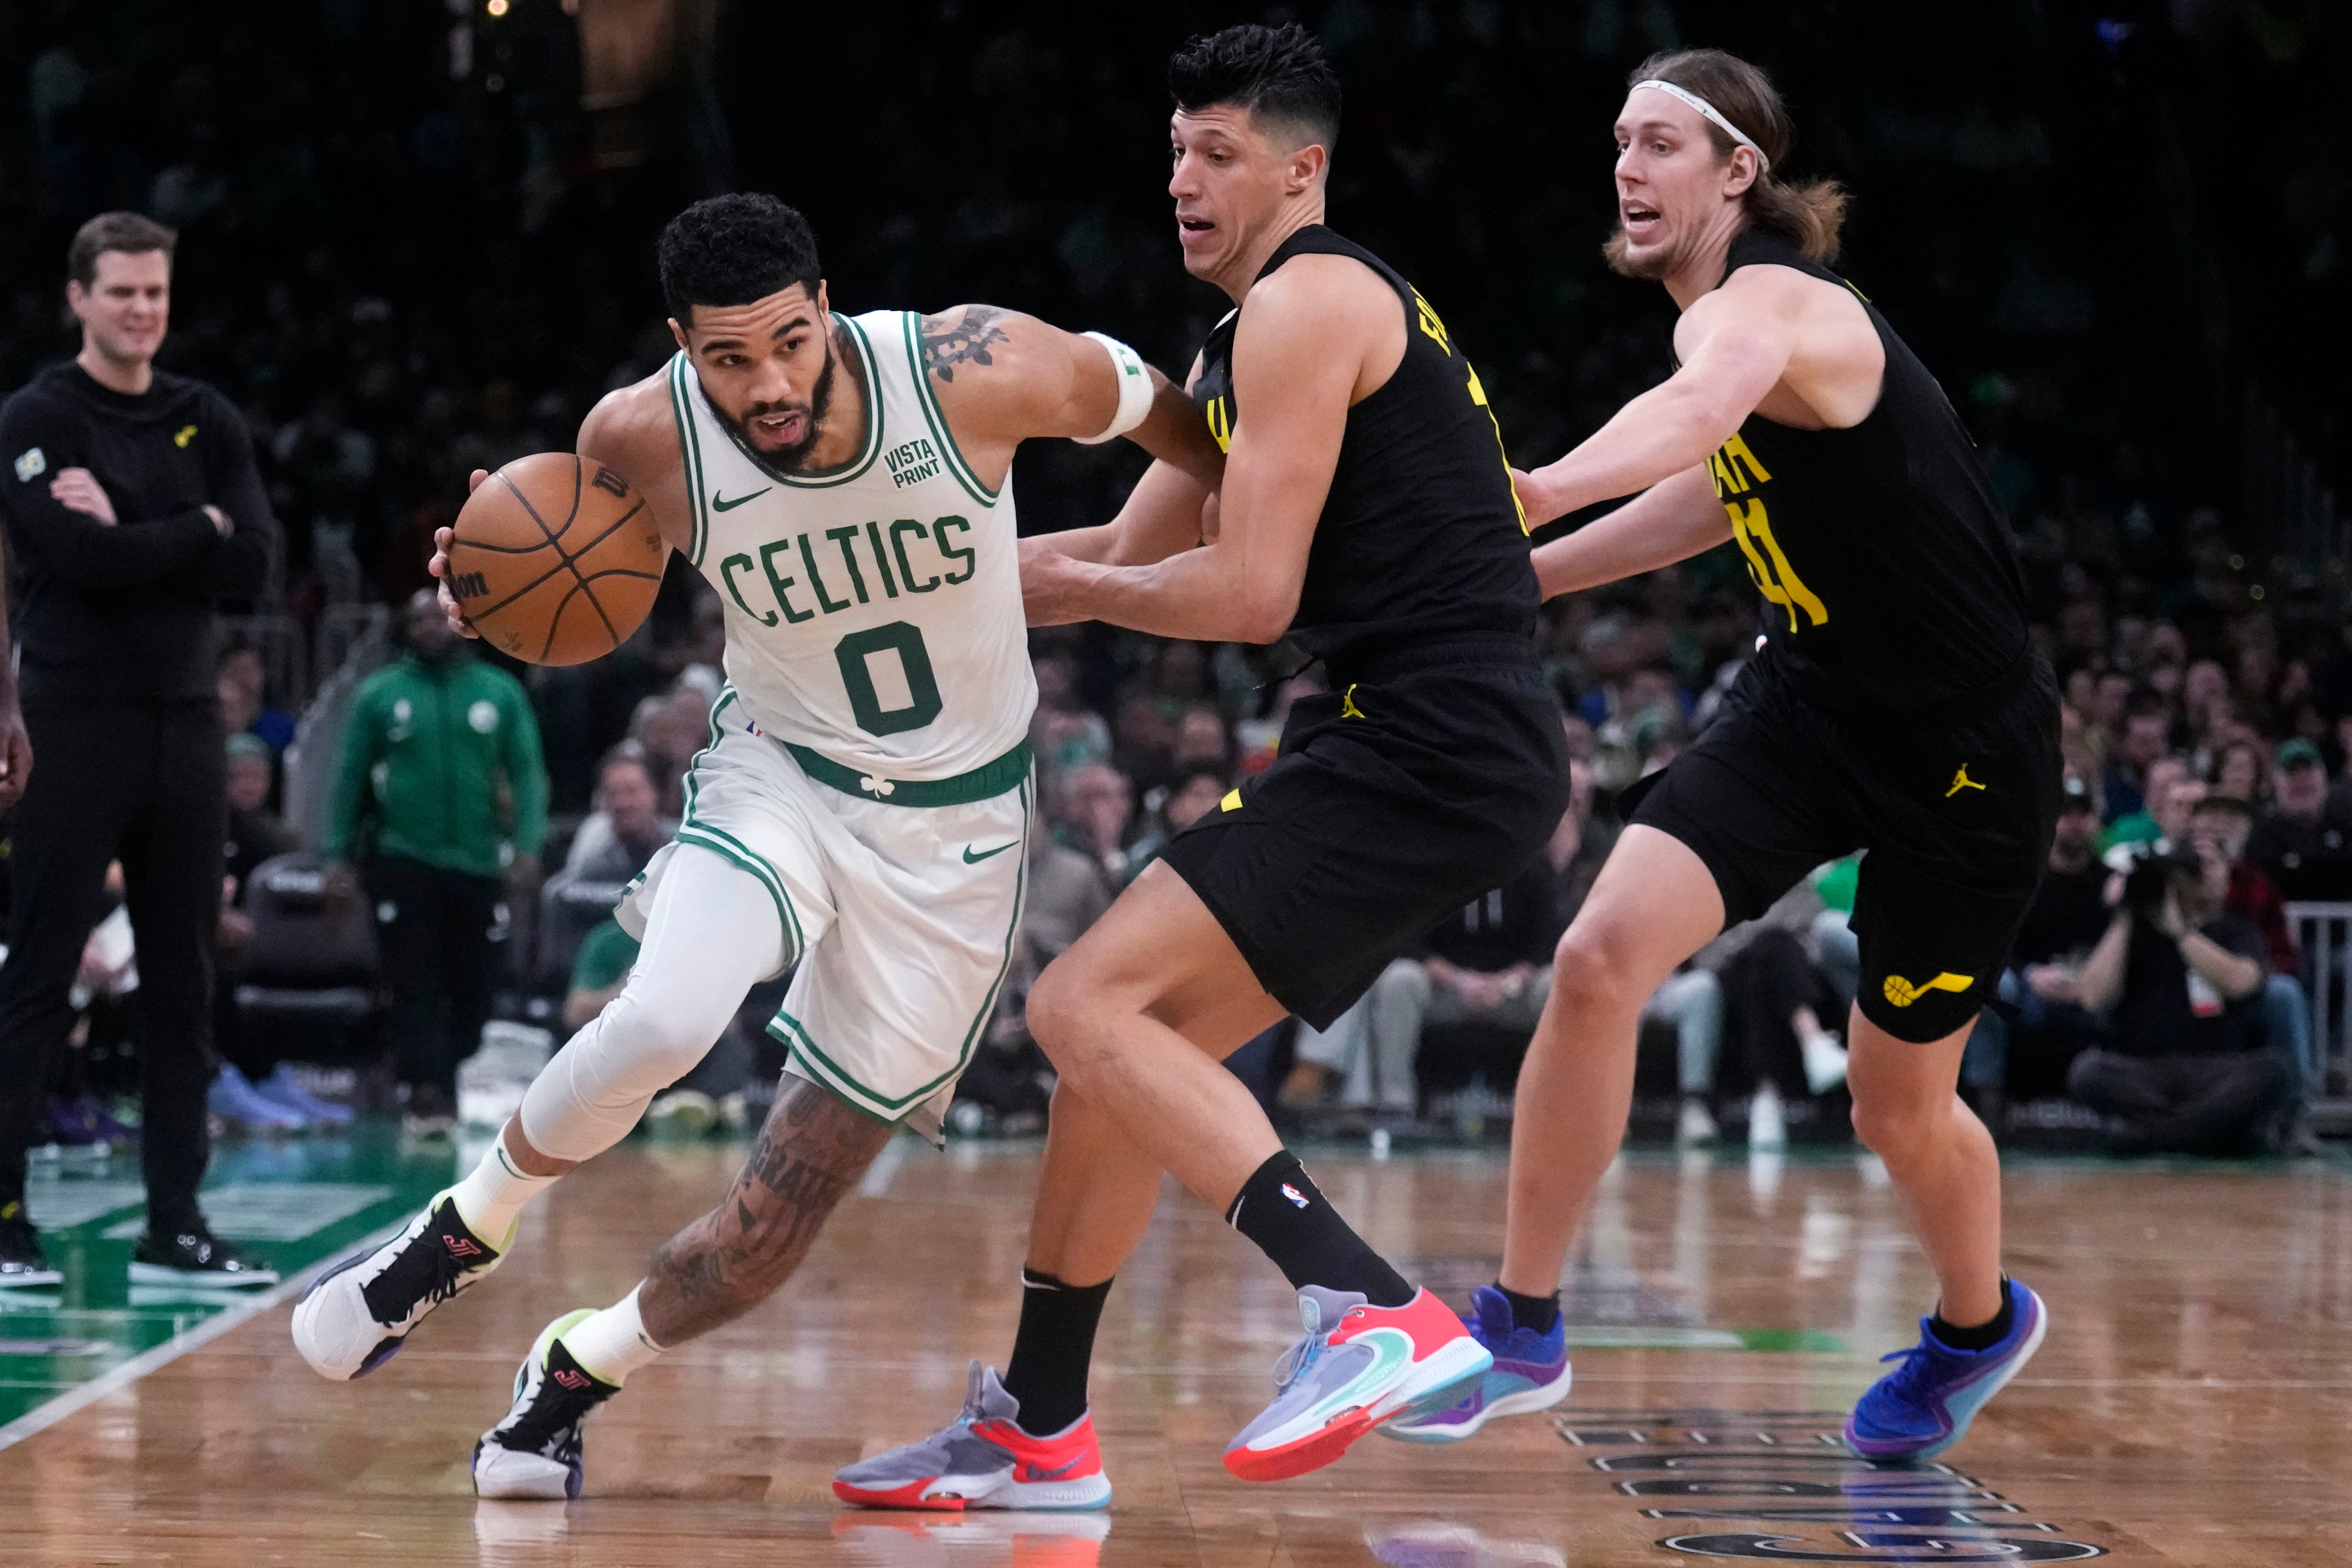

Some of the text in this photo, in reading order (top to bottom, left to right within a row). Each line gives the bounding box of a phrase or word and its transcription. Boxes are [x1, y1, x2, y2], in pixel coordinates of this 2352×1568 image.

[884, 439, 936, 473] VISTA
[893, 458, 940, 488] PRINT
[720, 515, 975, 627] CELTICS
[834, 620, 943, 736] 0
